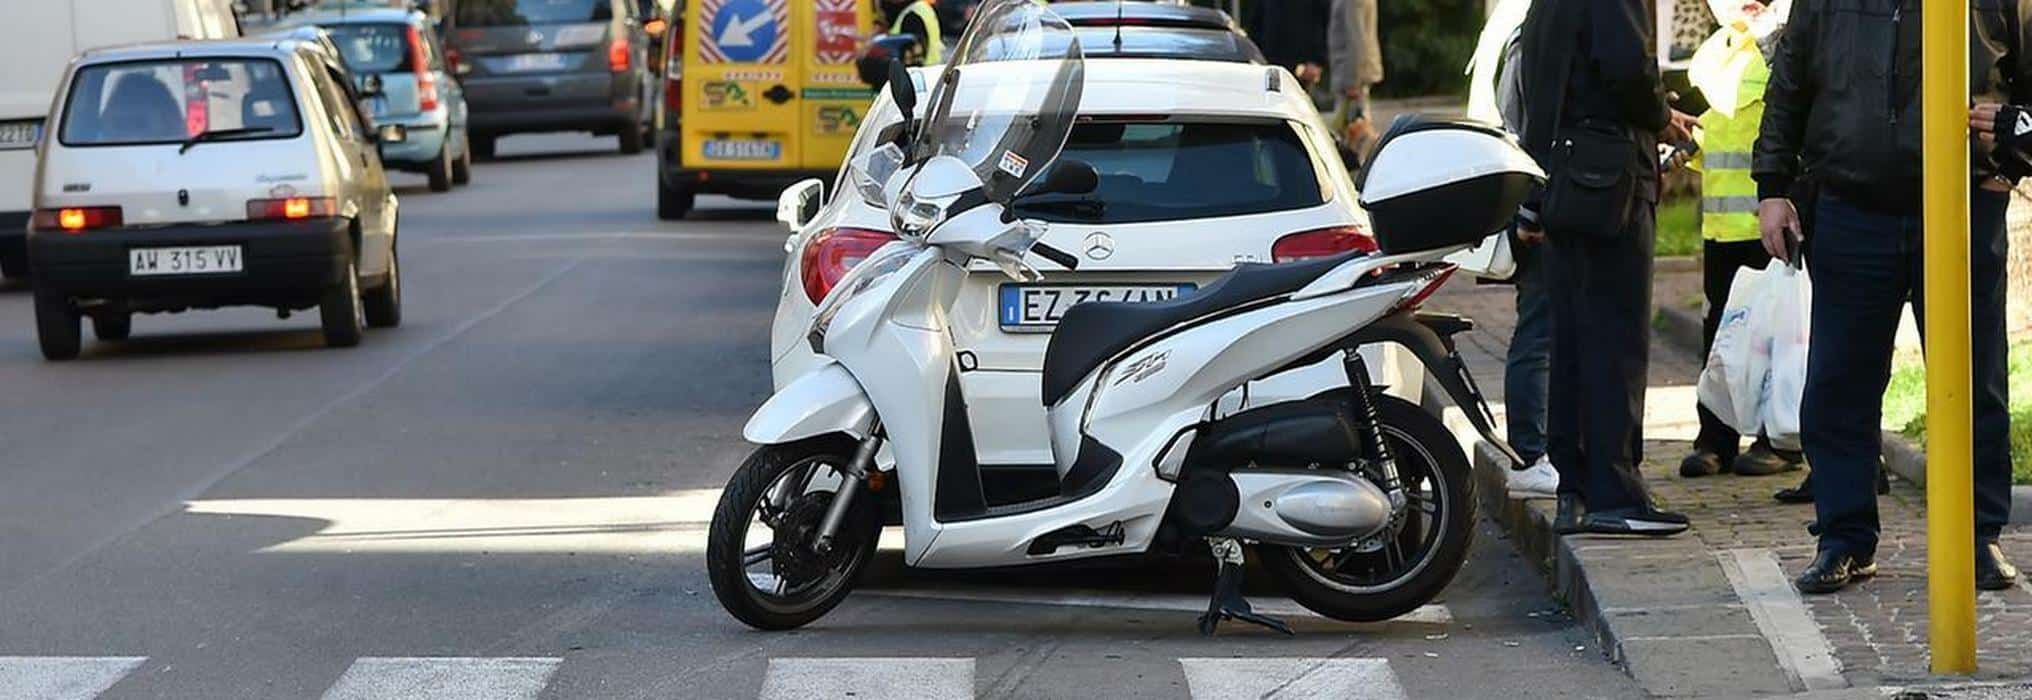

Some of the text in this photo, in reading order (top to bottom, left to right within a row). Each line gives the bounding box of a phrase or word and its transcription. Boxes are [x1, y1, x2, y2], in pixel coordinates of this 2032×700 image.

[136, 247, 237, 270] AW 315 VV
[1024, 290, 1061, 320] EZ
